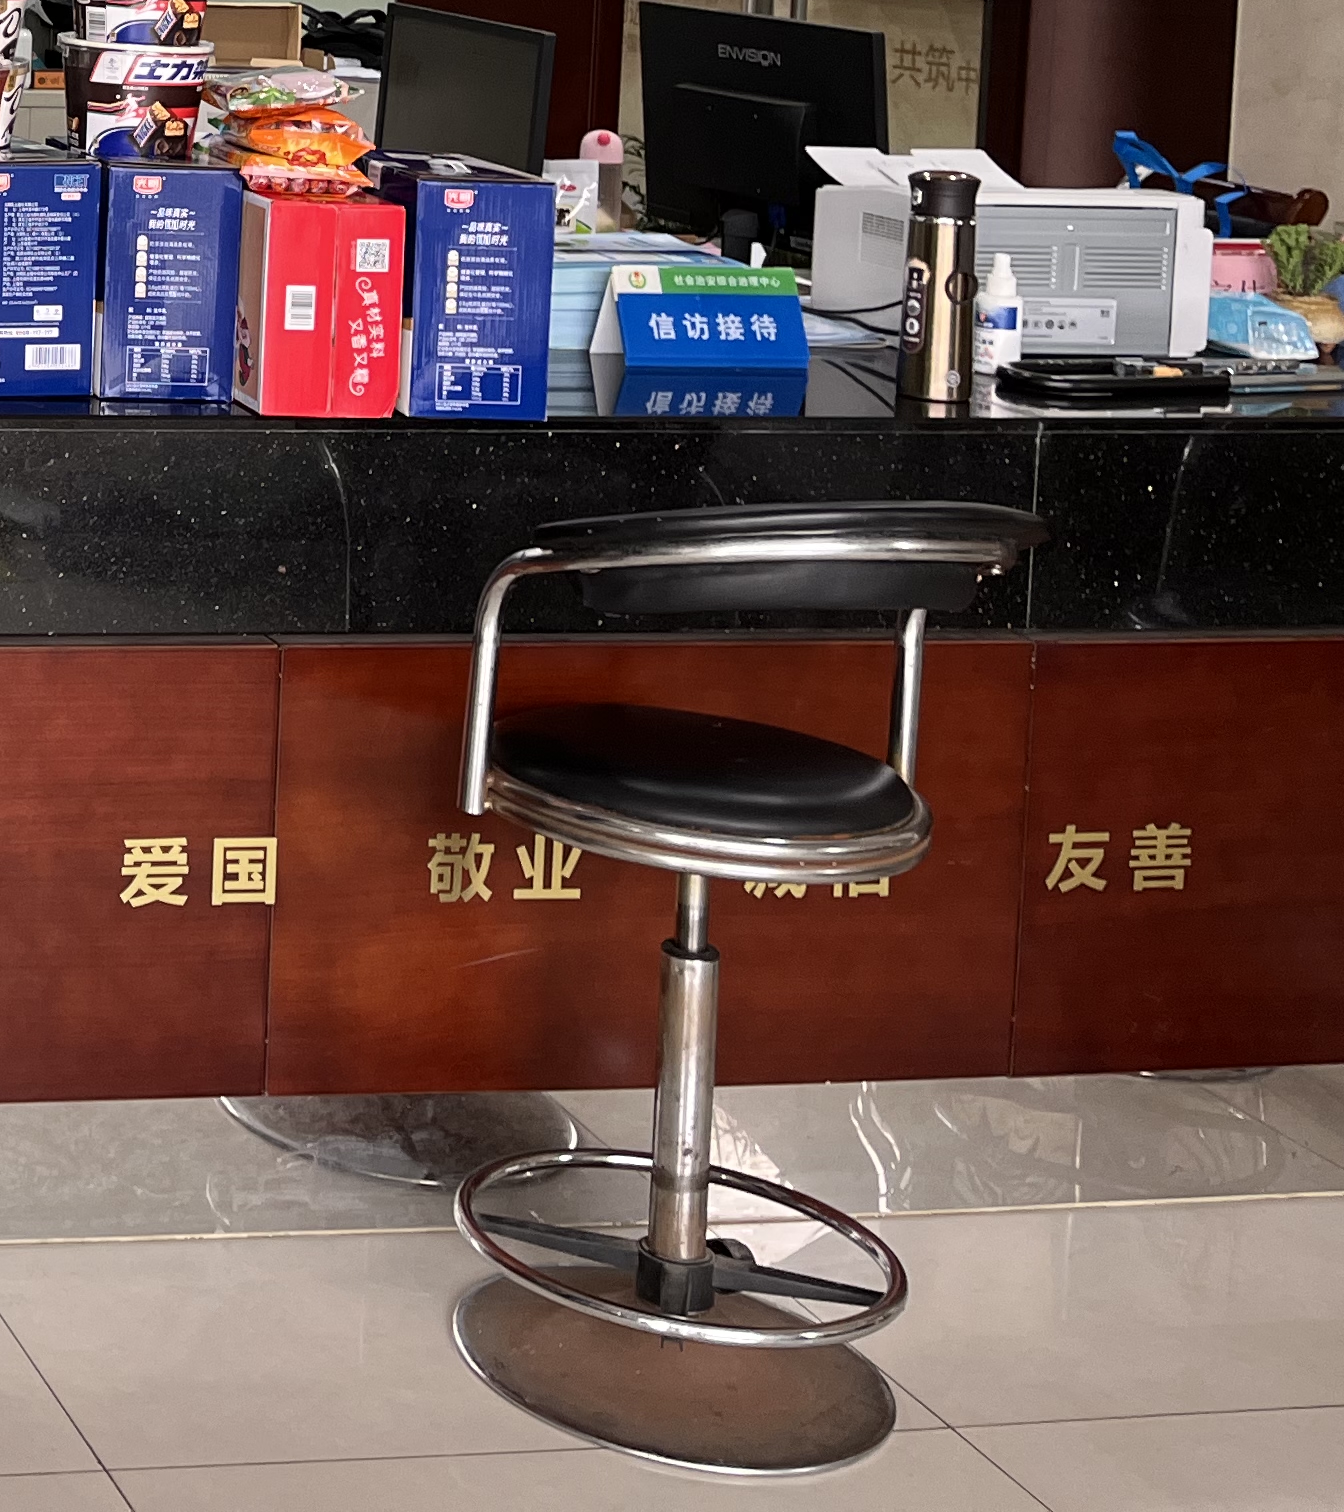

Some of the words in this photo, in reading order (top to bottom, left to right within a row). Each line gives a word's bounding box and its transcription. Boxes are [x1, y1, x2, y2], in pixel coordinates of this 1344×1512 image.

[717, 43, 781, 67] ENVISION
[648, 312, 778, 341] 信访接待
[118, 835, 280, 908] 爱国
[425, 831, 583, 904] 敬业
[1044, 822, 1193, 893] 友善
